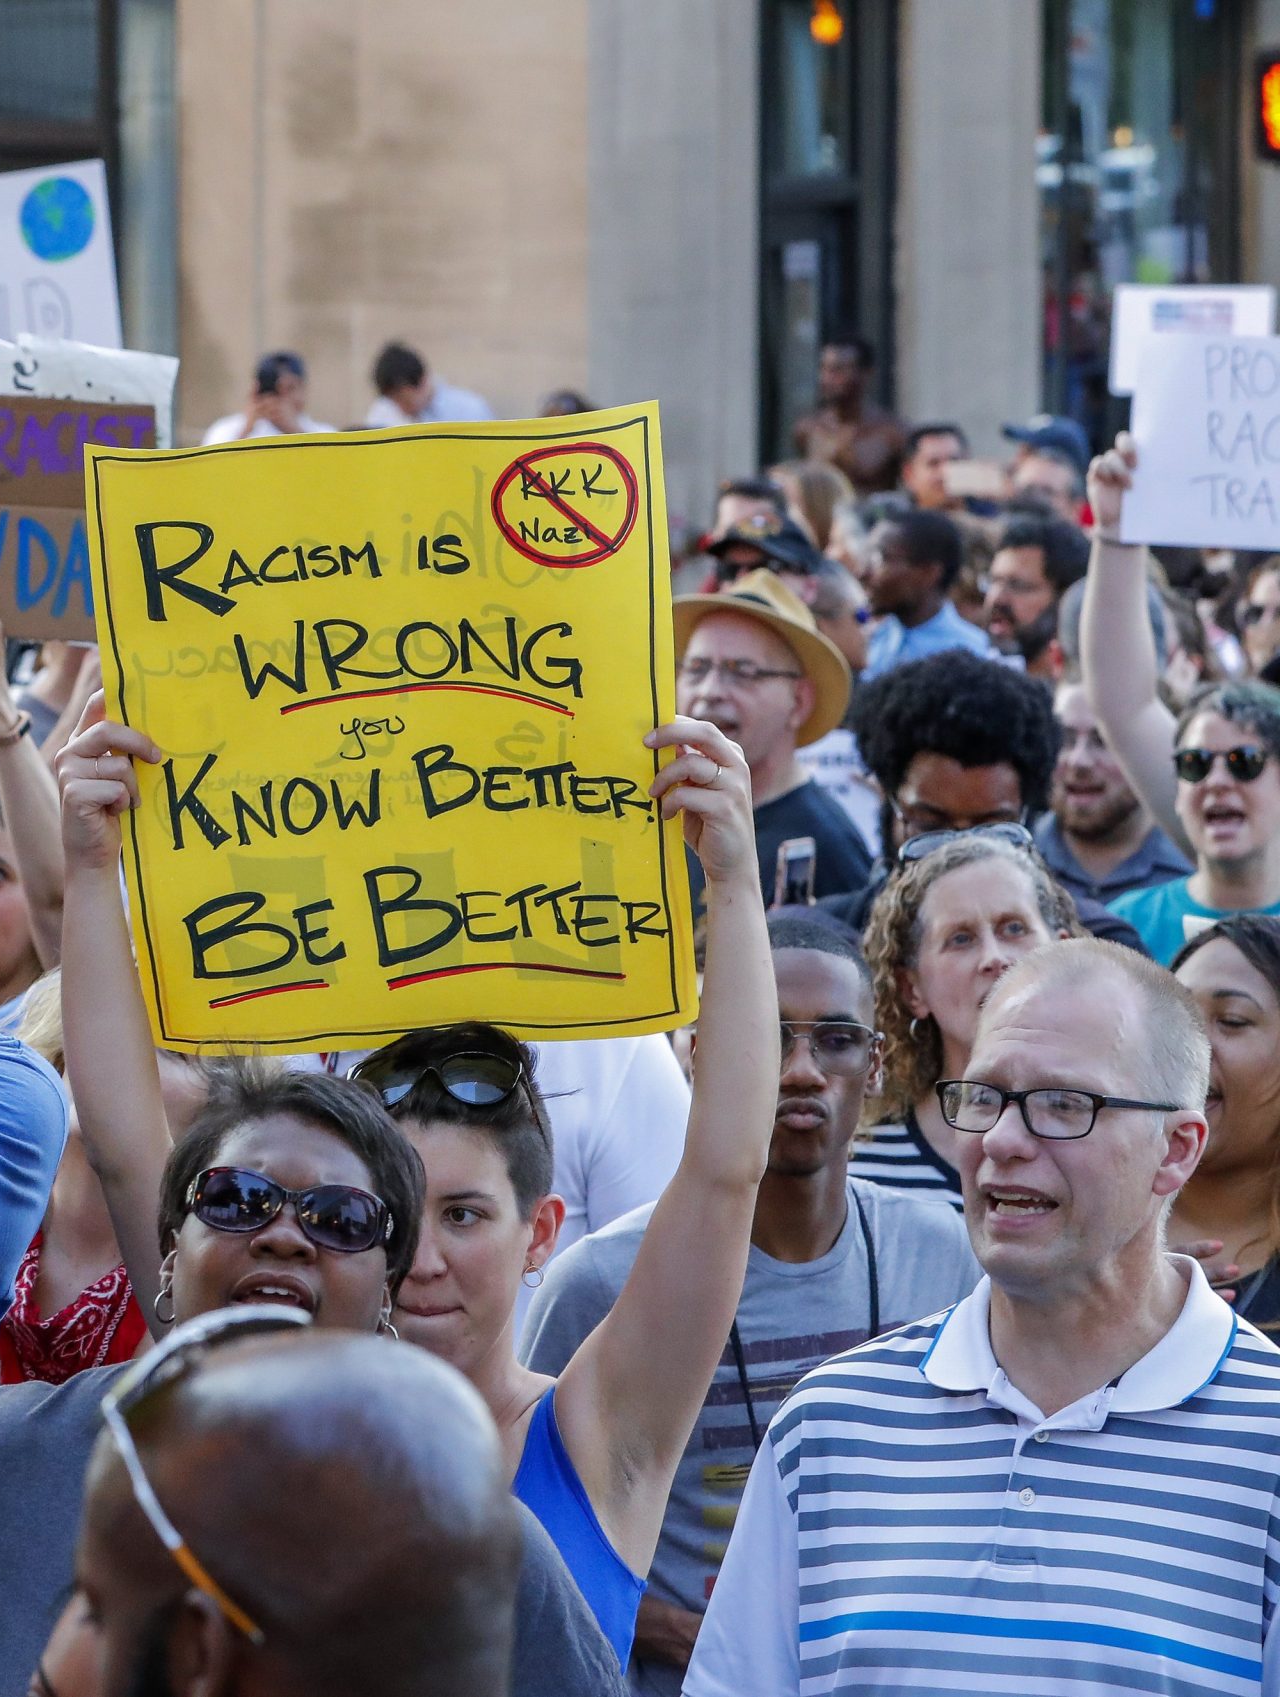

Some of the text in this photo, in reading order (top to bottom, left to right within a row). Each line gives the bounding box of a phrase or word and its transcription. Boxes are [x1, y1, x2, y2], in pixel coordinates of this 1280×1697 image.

[521, 464, 618, 500] KKK
[519, 517, 591, 544] Nazi
[418, 534, 471, 575] IS
[234, 617, 584, 699] WRONG
[339, 714, 406, 760] you
[163, 753, 381, 850] KNOW
[183, 865, 669, 979] BE BETTER
